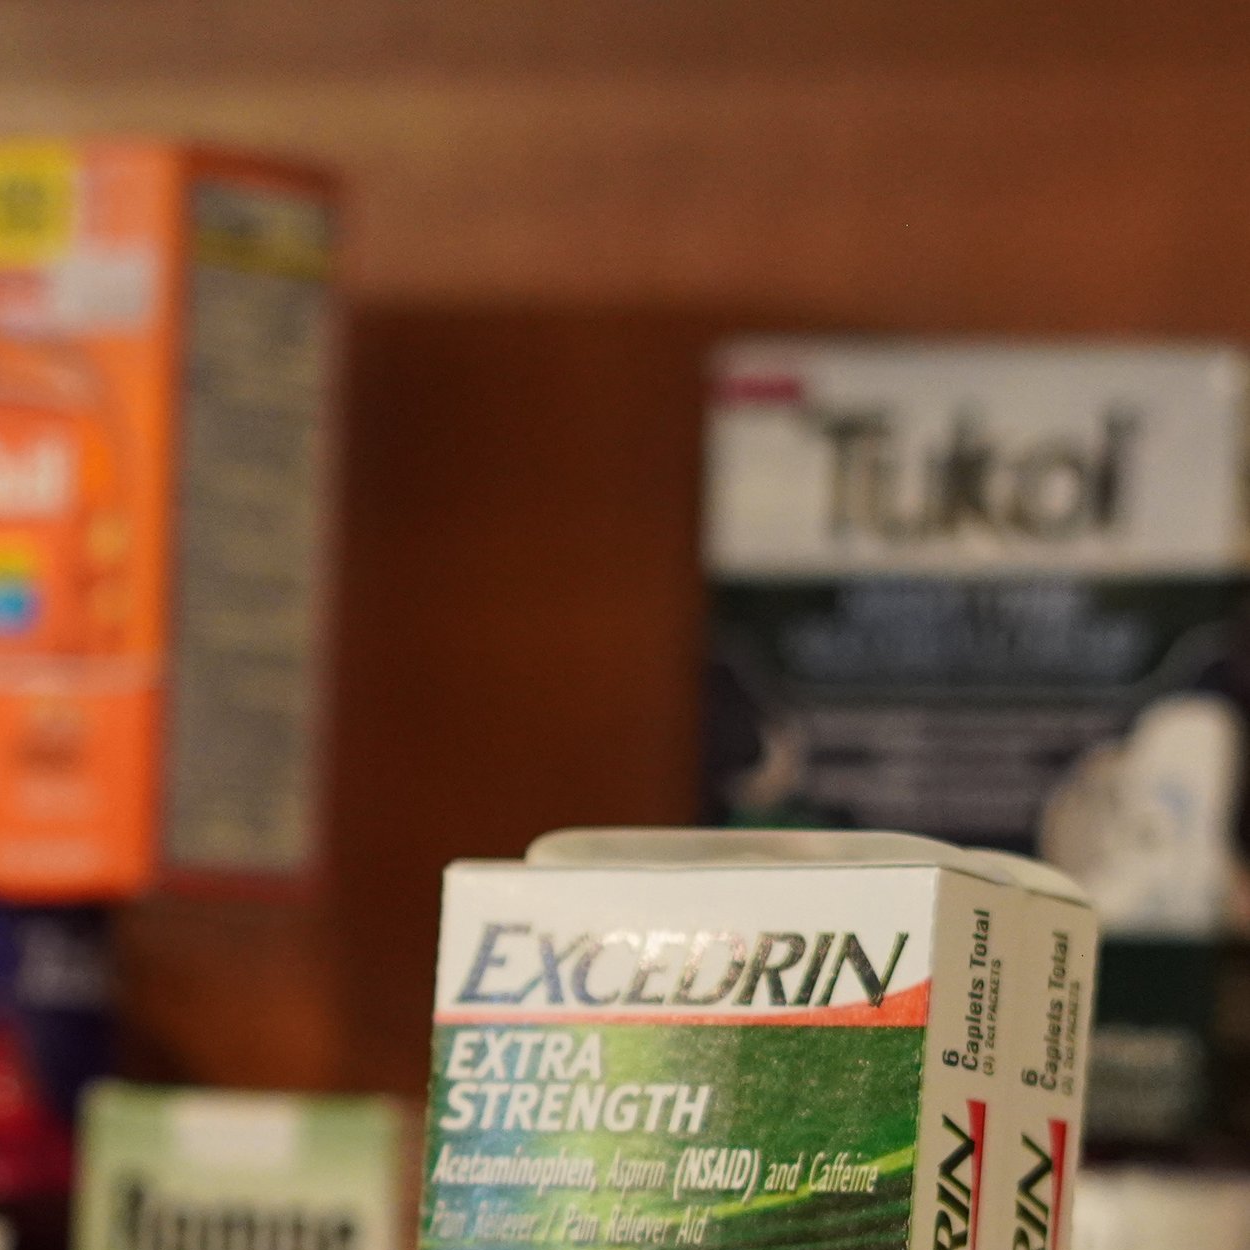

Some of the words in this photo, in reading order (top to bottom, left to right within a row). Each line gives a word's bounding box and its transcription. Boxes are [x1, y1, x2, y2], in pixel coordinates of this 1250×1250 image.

[455, 923, 909, 1008] EXCEDRIN
[970, 908, 990, 970] Total
[961, 976, 986, 1072] Caplets
[1040, 999, 1063, 1092] Caplets
[446, 1031, 601, 1080] EXTRA
[942, 1049, 960, 1067] 6
[440, 1083, 710, 1133] STRENGTH
[432, 1145, 596, 1197] Acetaminophen,
[673, 1148, 761, 1203] (NSAID)
[764, 1152, 804, 1191] and
[808, 1152, 879, 1193] Caffeine
